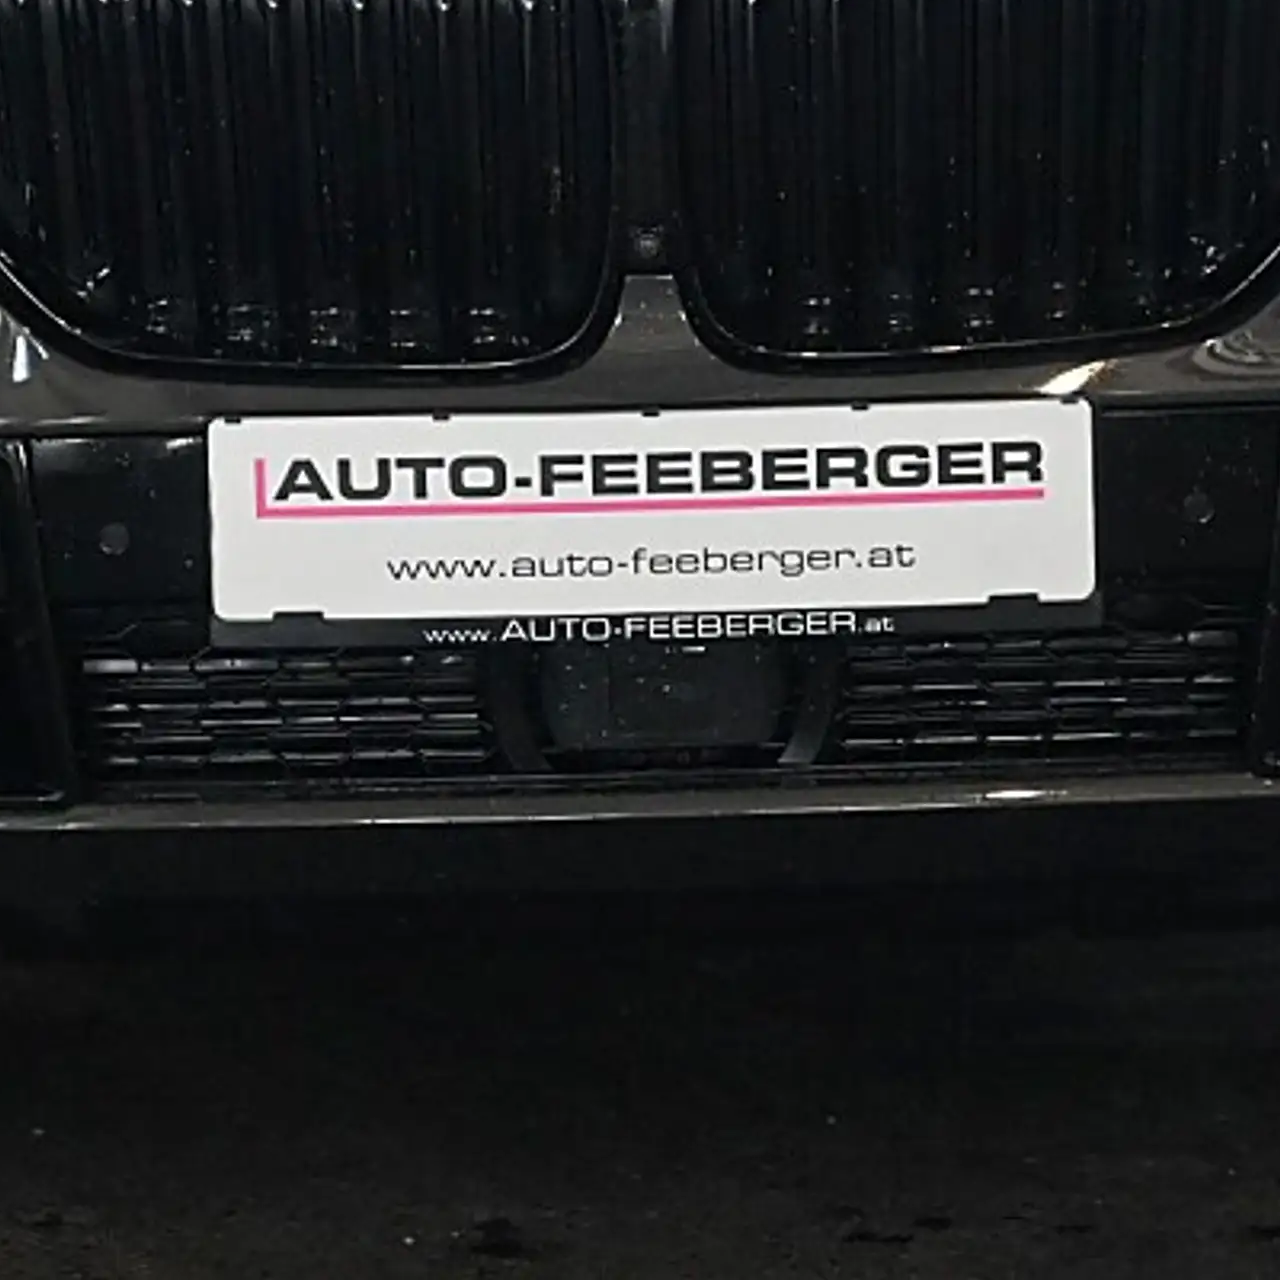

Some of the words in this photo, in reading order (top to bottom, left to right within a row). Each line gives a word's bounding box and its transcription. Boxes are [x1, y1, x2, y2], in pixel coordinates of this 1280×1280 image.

[274, 440, 1044, 501] AUTO-FEEBERGER
[386, 544, 916, 580] www.auto-feeberger.at
[423, 610, 895, 643] www.AUTO-FEEBERGER.at
